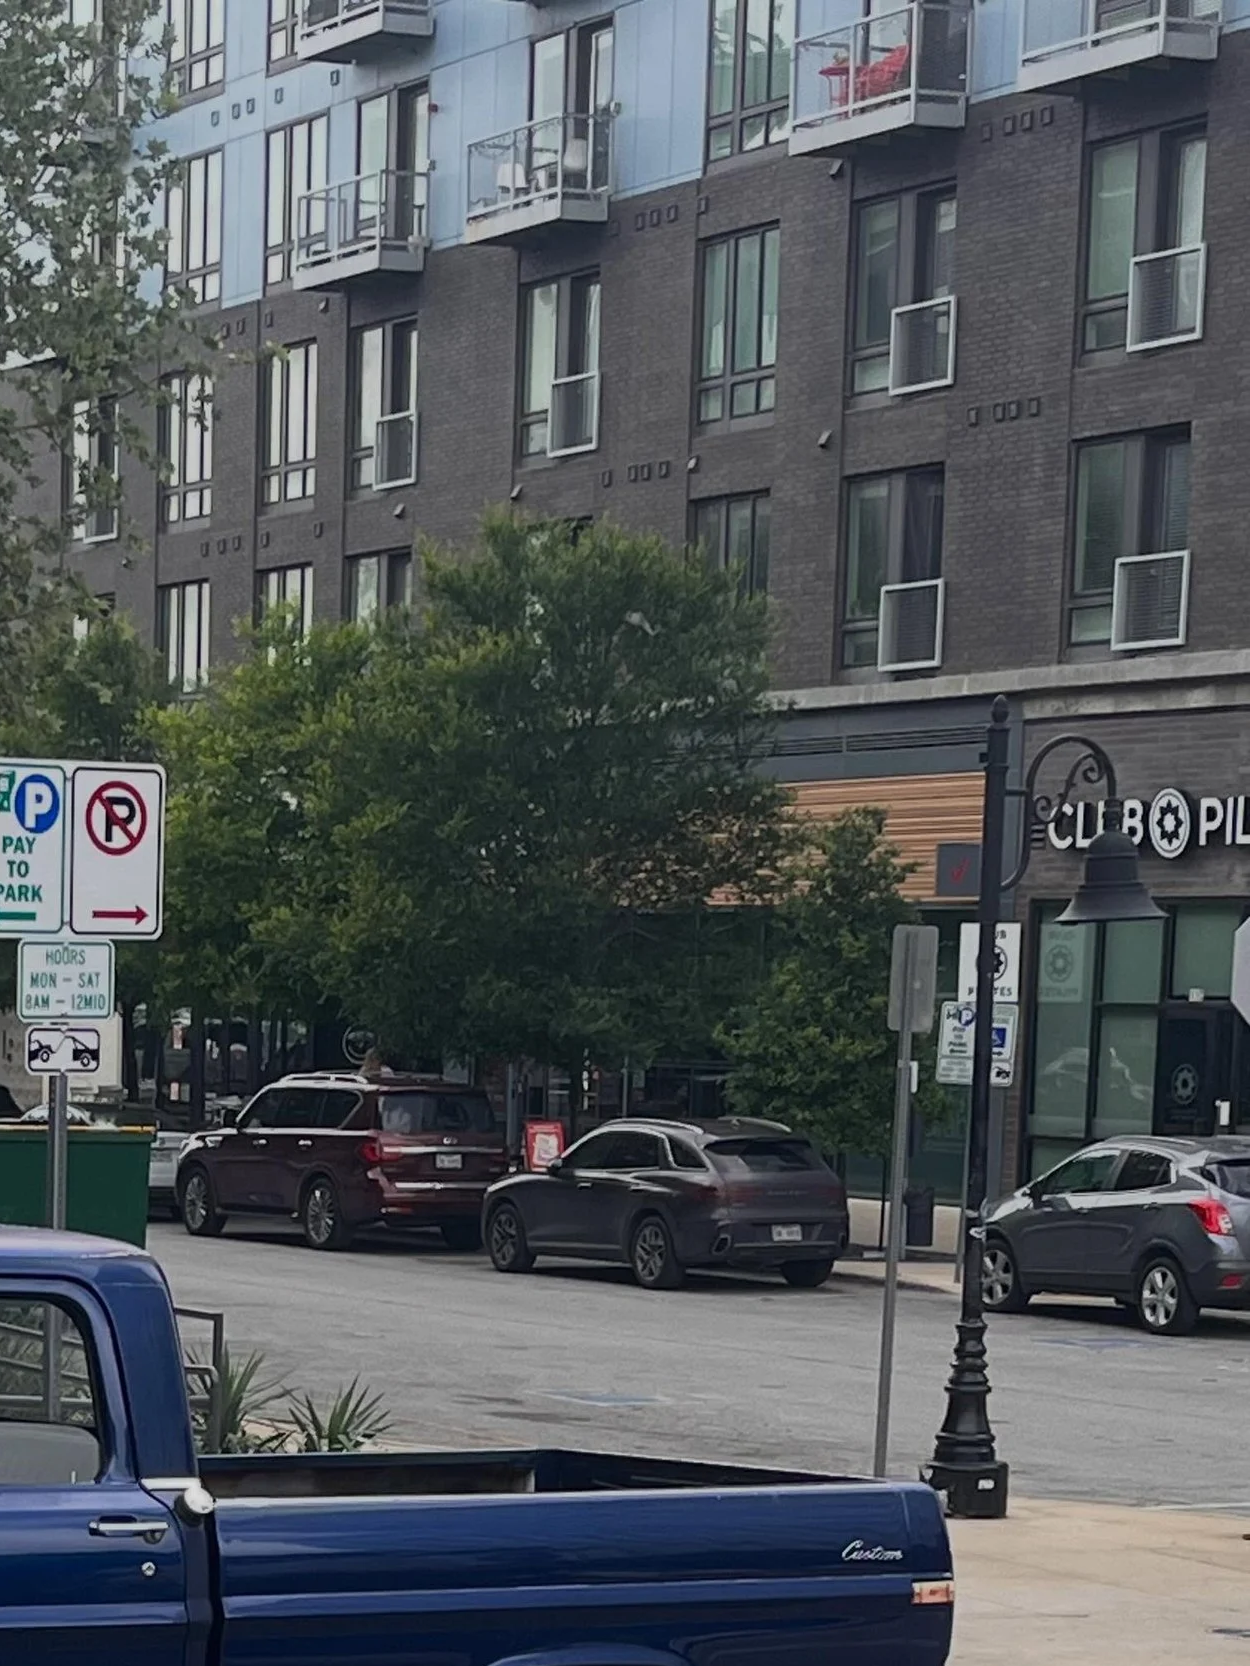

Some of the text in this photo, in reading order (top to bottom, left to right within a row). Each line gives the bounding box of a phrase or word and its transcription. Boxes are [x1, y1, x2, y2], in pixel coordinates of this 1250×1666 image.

[2, 836, 36, 854] PAY
[7, 860, 30, 878] TO
[46, 948, 86, 965] HOURS
[30, 972, 57, 988] MON
[78, 972, 101, 988] SAT
[841, 1540, 903, 1561] Custom
